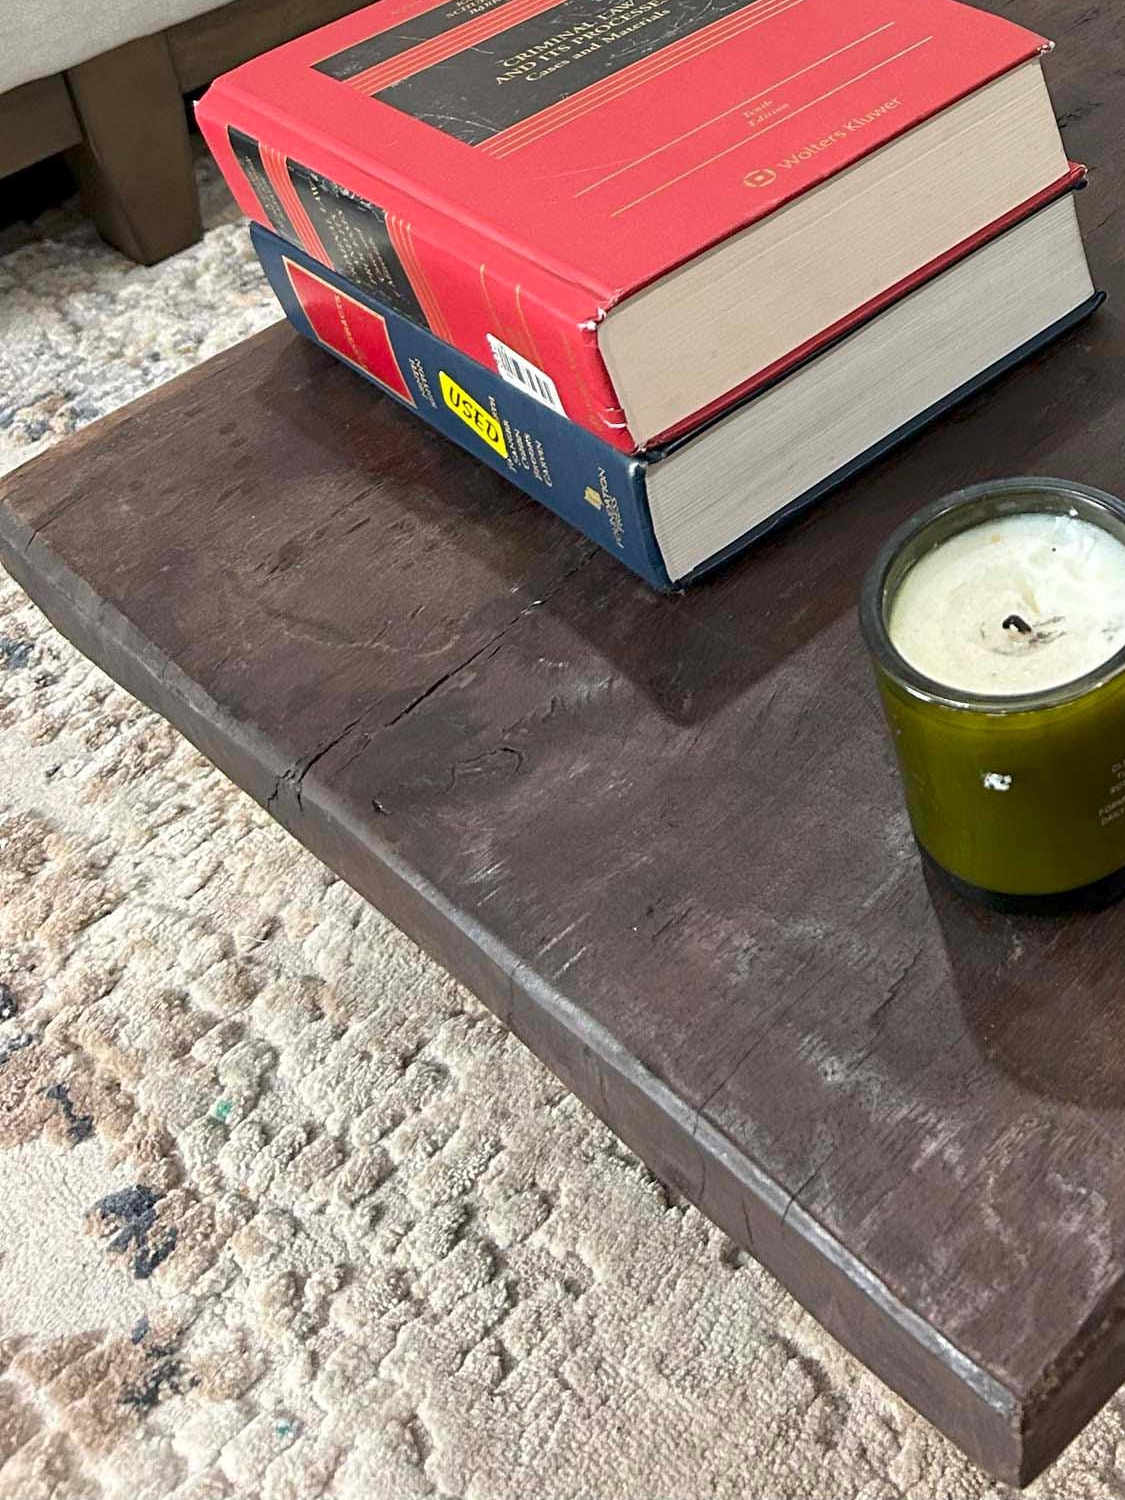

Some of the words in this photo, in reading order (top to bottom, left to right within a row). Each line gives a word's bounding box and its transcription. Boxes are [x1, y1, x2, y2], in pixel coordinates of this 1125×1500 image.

[495, 61, 537, 85] AND
[539, 44, 572, 62] ITS
[503, 21, 599, 68] CRIMINAL
[597, 0, 636, 21] LAW
[525, 58, 571, 82] Cases
[572, 42, 601, 60] and
[601, 9, 672, 45] Materials
[776, 130, 847, 170] Wolters
[843, 97, 904, 133] Kluwer
[448, 386, 499, 444] USED
